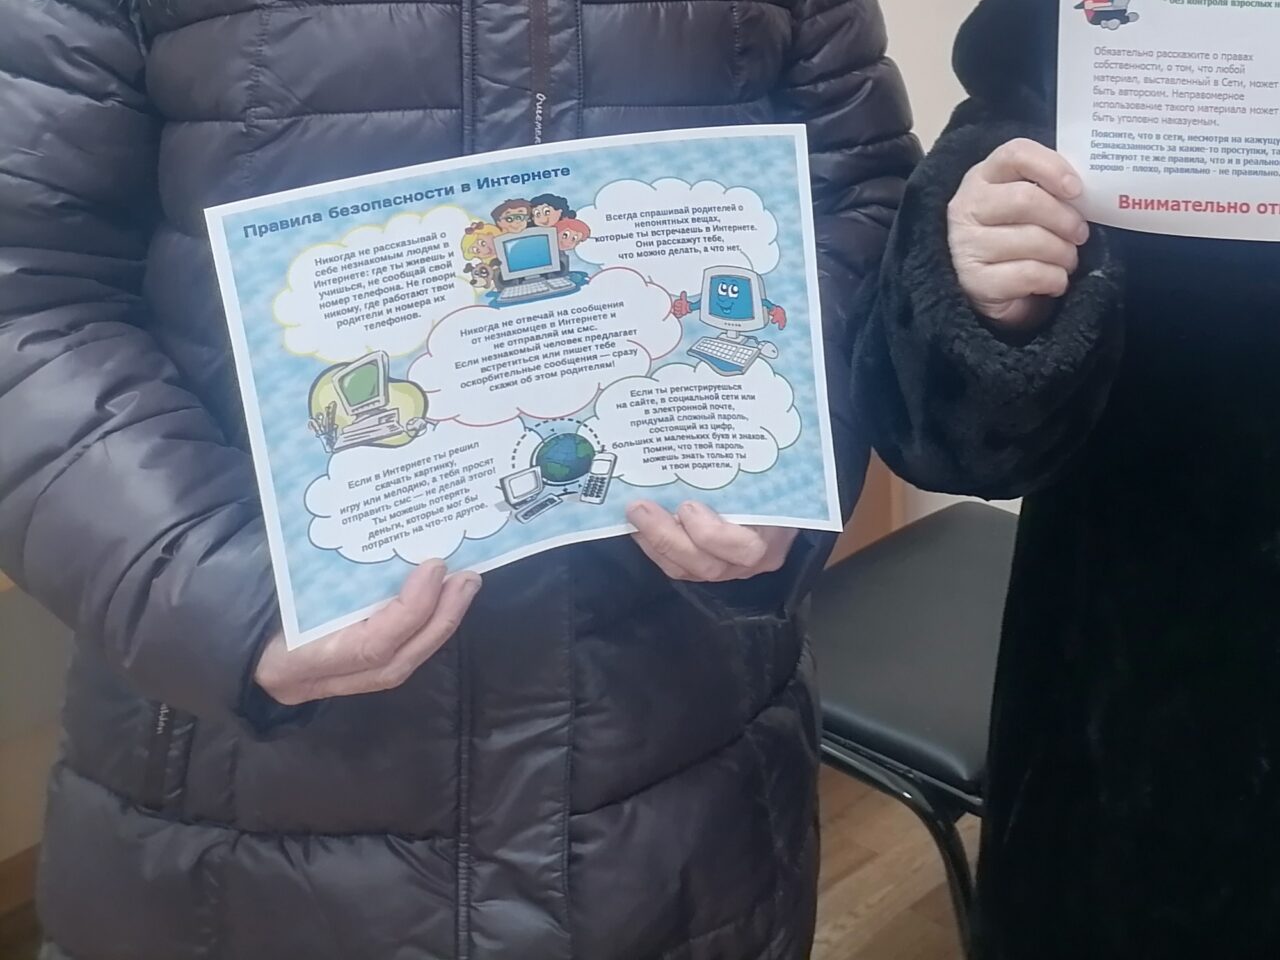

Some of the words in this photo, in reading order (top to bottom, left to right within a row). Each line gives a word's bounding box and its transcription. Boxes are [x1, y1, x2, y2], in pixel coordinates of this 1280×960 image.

[244, 214, 322, 238] Правила
[329, 187, 455, 220] безопасности
[462, 184, 471, 194] в
[477, 167, 571, 190] Интернете
[605, 212, 638, 222] Всегда
[639, 205, 690, 219] спрашивай
[691, 203, 736, 215] родителей
[1118, 194, 1249, 213] Внимательно
[594, 232, 634, 242] которые
[650, 226, 703, 238] встречаешь
[712, 223, 758, 233] Интернете.
[634, 217, 689, 228] непонятных
[690, 216, 721, 224] вещах,
[314, 251, 356, 266] Никогда
[358, 248, 371, 257] не
[373, 232, 438, 256] рассказывай
[315, 265, 338, 277] себе
[341, 252, 404, 272] незнакомым
[406, 244, 441, 258] людям
[313, 270, 369, 288] Интернете:
[371, 266, 388, 276] где
[391, 263, 404, 272] ты
[406, 254, 445, 269] живешь
[319, 282, 366, 300] учишься,
[368, 278, 380, 287] не
[382, 266, 426, 284] сообщай
[428, 260, 453, 274] свой
[319, 296, 350, 309] номер
[352, 286, 403, 302] телефона.
[406, 280, 420, 290] Не
[422, 273, 456, 287] говори
[324, 305, 362, 319] никому,
[364, 300, 380, 310] где
[382, 288, 429, 308] работают
[432, 282, 455, 294] твои
[336, 310, 384, 330] родители
[395, 299, 432, 313] номера
[433, 295, 446, 304] их
[364, 311, 422, 330] телефонов.
[460, 323, 500, 337] Никогда
[501, 320, 514, 329] не
[516, 310, 555, 326] отвечай
[557, 309, 569, 317] на
[570, 301, 624, 315] сообщения
[471, 336, 481, 344] от
[484, 323, 547, 342] незнакомцев
[558, 313, 608, 327] Интернете
[454, 358, 479, 369] Если
[481, 343, 541, 364] незнакомый
[543, 337, 583, 350] человек
[585, 329, 637, 344] предлагает
[493, 341, 505, 350] не
[507, 329, 559, 347] отправляй
[561, 328, 575, 337] им
[576, 324, 599, 334] смс.
[460, 365, 542, 389] оскорбительные
[544, 354, 598, 371] сообщения
[612, 348, 638, 359] сразу
[480, 355, 540, 374] встретиться
[542, 351, 561, 360] или
[562, 345, 592, 356] пишет
[595, 340, 616, 351] тебе
[489, 379, 518, 392] скажи
[520, 374, 533, 385] об
[535, 371, 558, 382] этом
[560, 359, 615, 379] родителям!
